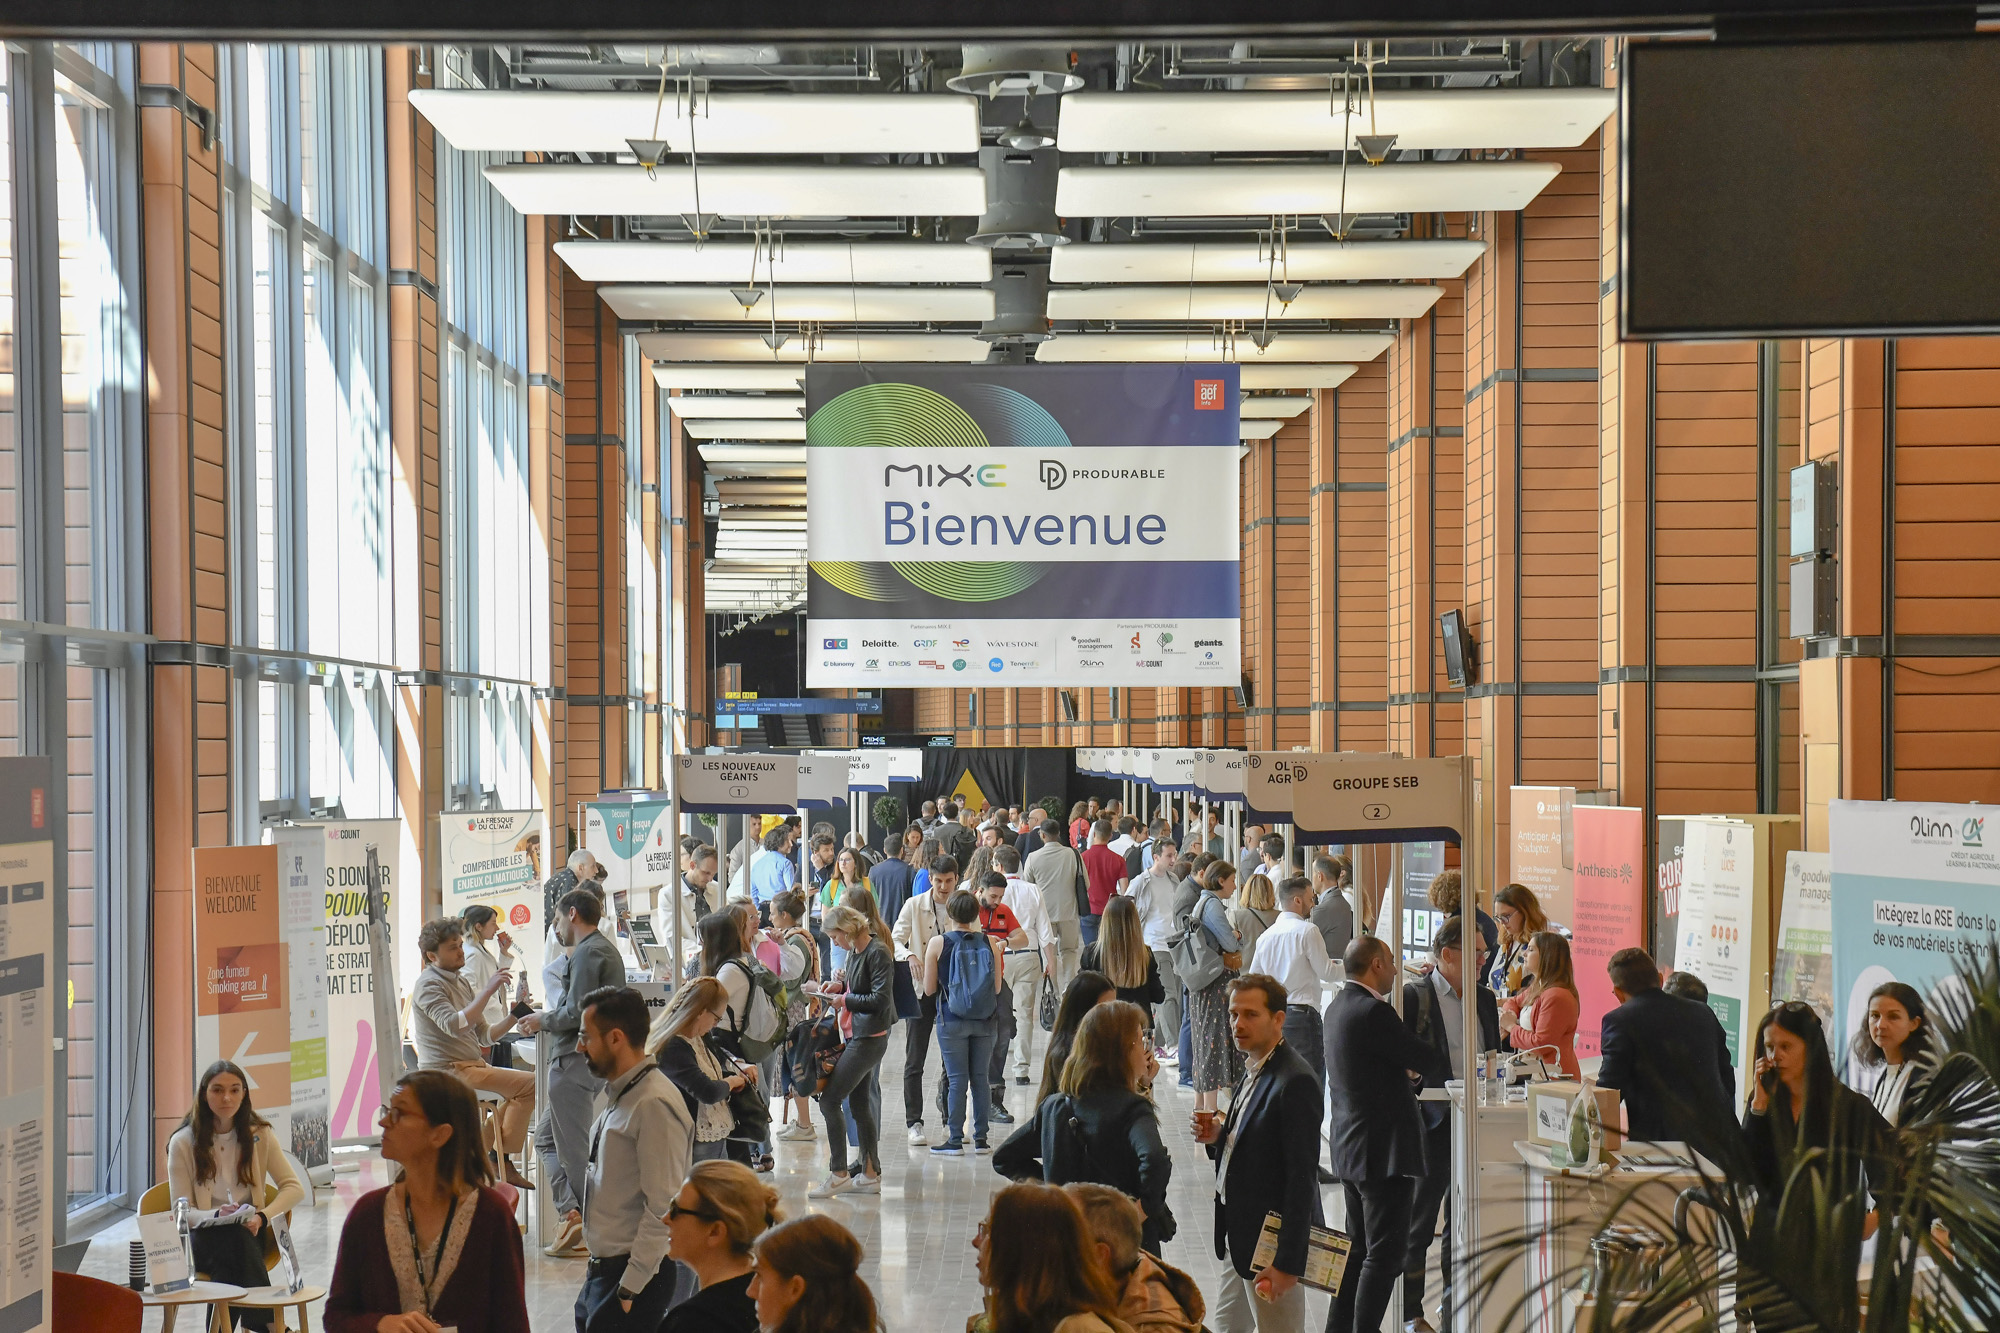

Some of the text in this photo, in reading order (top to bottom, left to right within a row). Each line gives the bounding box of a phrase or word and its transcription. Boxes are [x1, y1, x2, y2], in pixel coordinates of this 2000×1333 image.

[1200, 384, 1218, 400] aef
[1072, 469, 1166, 479] PRODURABLE
[884, 500, 1167, 546] Bienvenue
[825, 640, 846, 648] CIC
[914, 640, 938, 648] GRDF
[702, 762, 776, 772] LES NOUVEAUX
[1274, 761, 1290, 771] OL
[720, 771, 758, 782] GÉANTS
[1267, 774, 1292, 784] AGR
[1332, 776, 1419, 790] GROUPE SEB
[1373, 808, 1380, 818] 2
[1910, 816, 1953, 838] Olinn
[462, 854, 523, 874] COMPRENDRE LES
[646, 852, 672, 862] LA FRESQUE
[1970, 853, 1995, 861] AGRICOLE
[648, 863, 655, 871] DU
[1576, 862, 1618, 878] Anthesis
[1721, 859, 1736, 872] LUCIE
[205, 874, 262, 894] BIENVENUE
[457, 868, 529, 891] ENJEUX CLIMATIQUES
[206, 894, 256, 914] WELCOME
[1876, 904, 1996, 932] Intégrez la RSE dans la
[1874, 929, 1886, 945] de
[1888, 934, 1904, 948] vos
[1907, 934, 1955, 954] matériels
[208, 965, 251, 980] Zone fumeur
[207, 980, 256, 995] Smoking area
[350, 974, 364, 993] ET
[148, 1247, 181, 1257] INTERVENANTS
